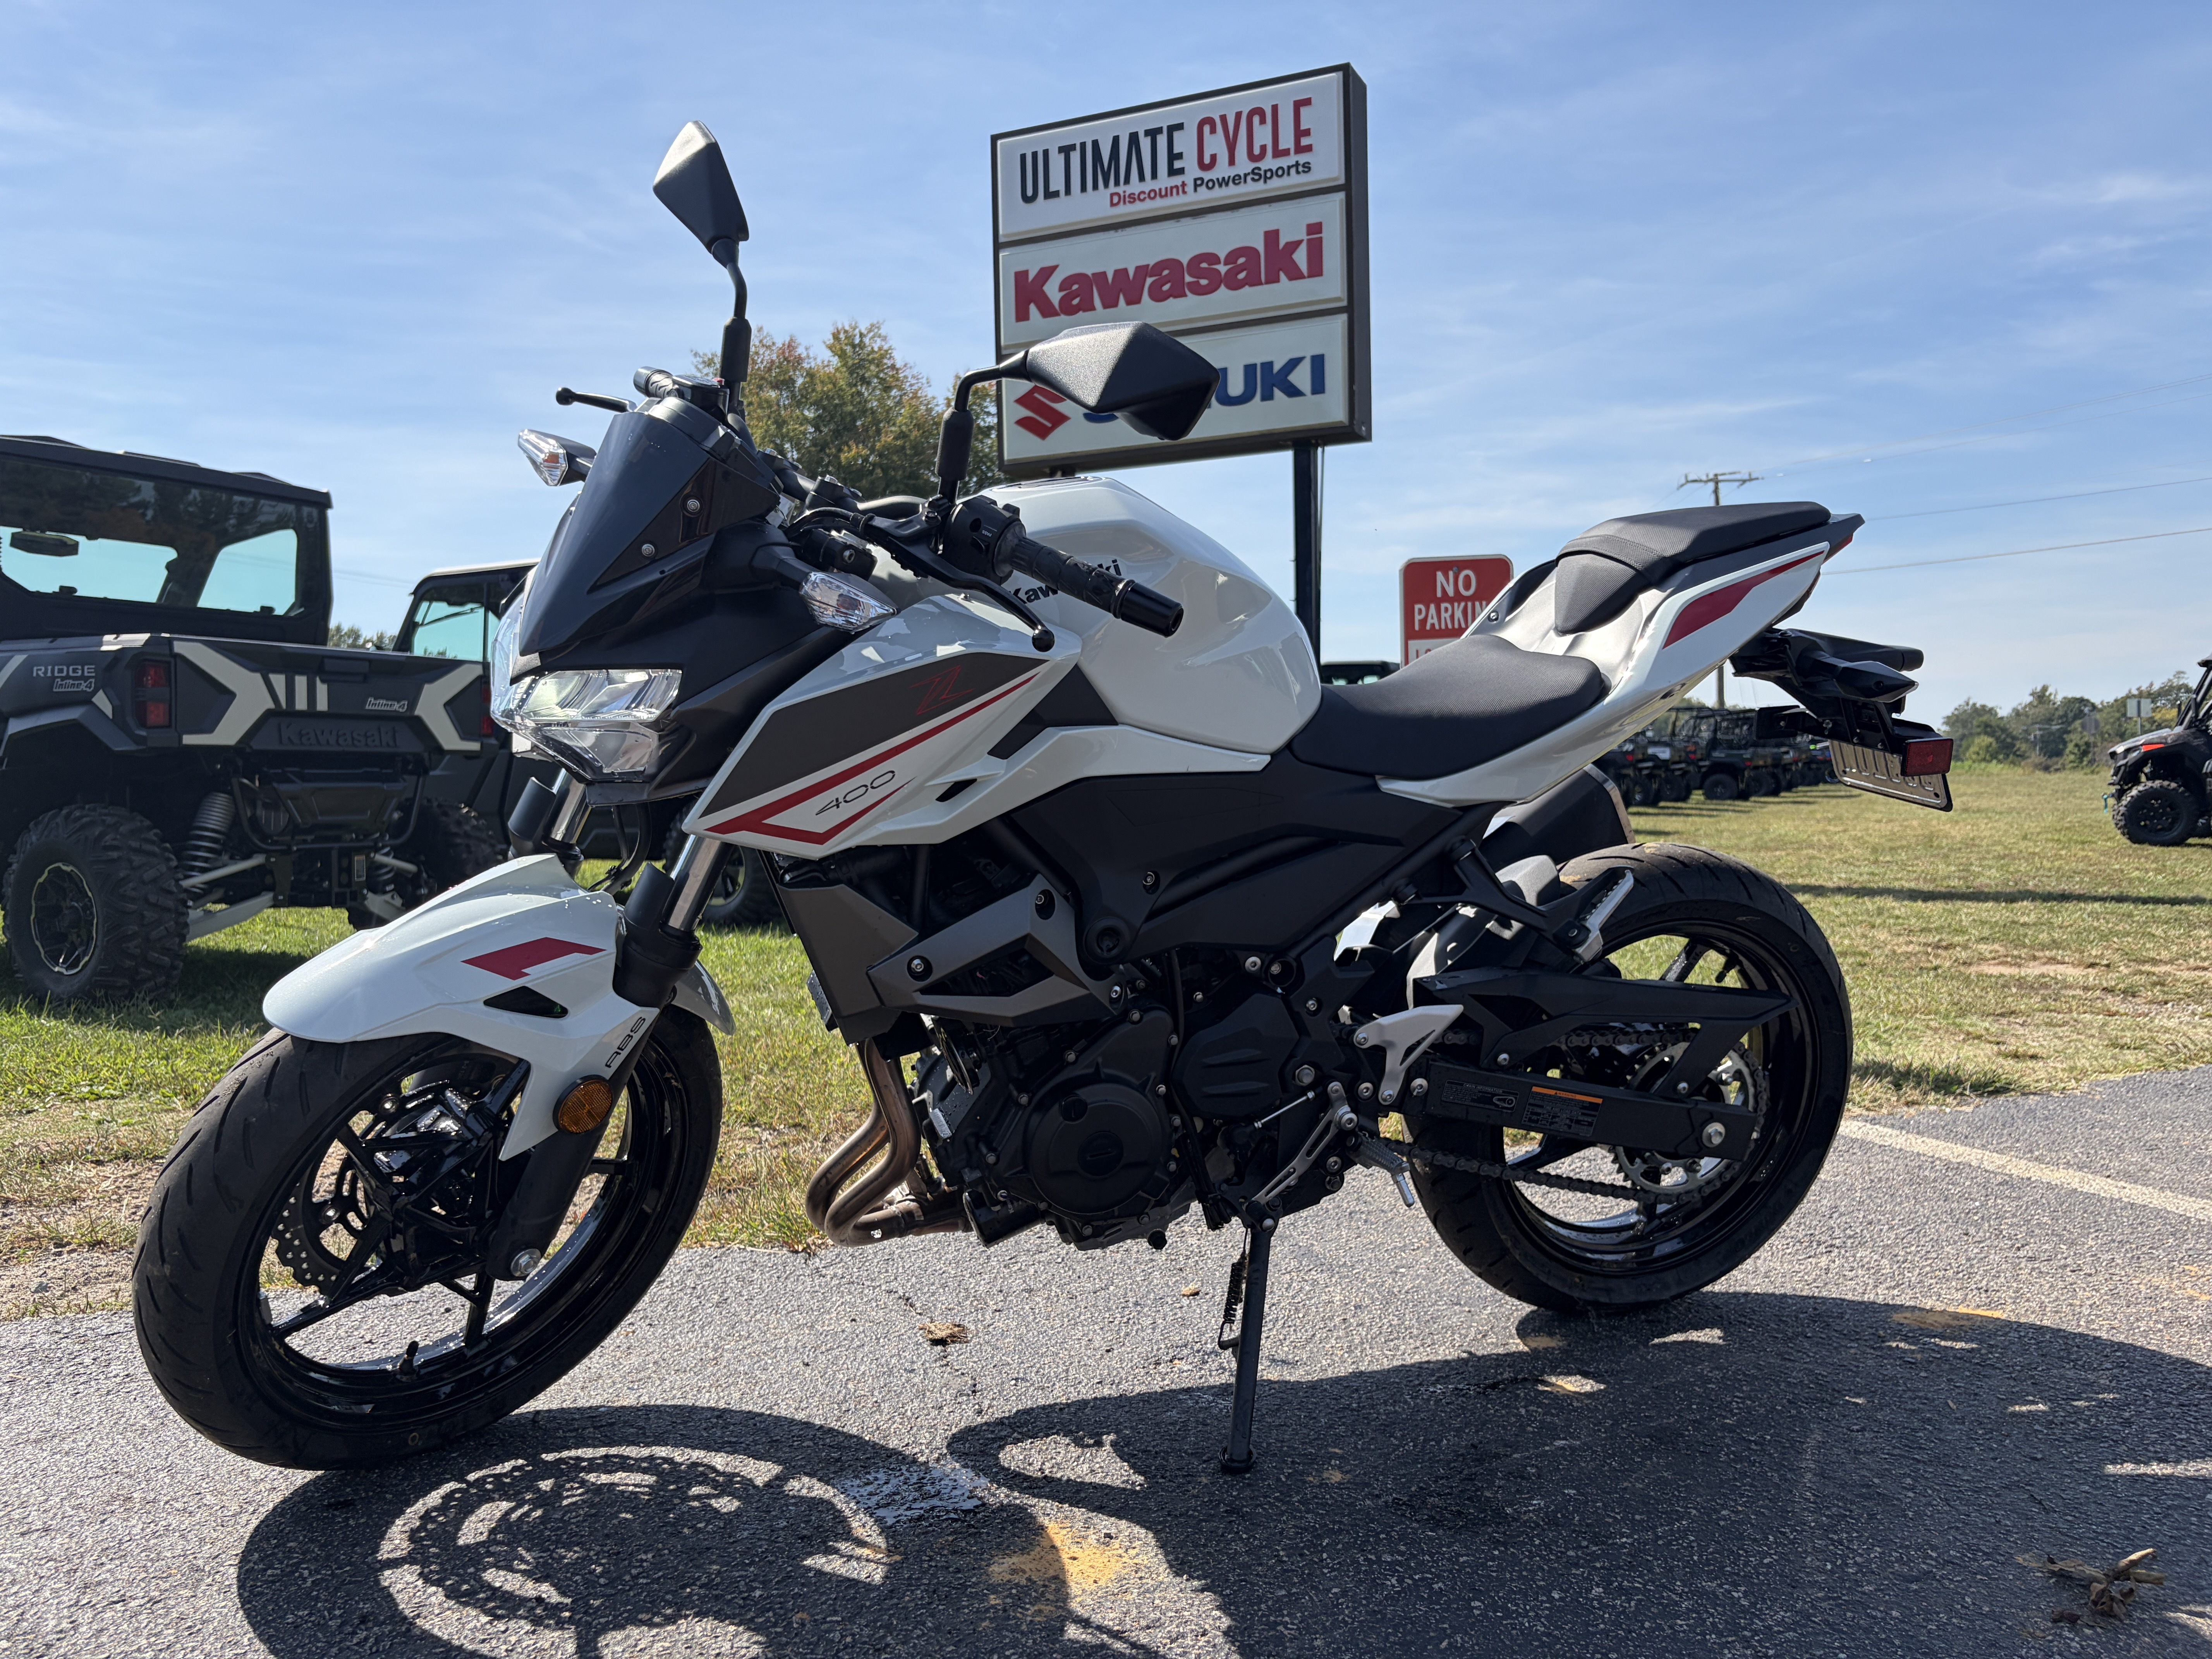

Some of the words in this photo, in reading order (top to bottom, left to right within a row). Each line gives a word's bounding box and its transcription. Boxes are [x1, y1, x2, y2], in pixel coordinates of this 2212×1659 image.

[1019, 122, 1185, 204] ULTIMATE
[1196, 96, 1313, 172] CYCLE
[1109, 180, 1188, 208] Discount
[1193, 159, 1312, 192] PowerSports
[1014, 221, 1324, 323] Kawasaki
[1436, 570, 1476, 598] NO
[1414, 601, 1486, 631] PARKIN
[33, 665, 95, 677] RIDGE
[277, 722, 400, 748] Kawasaki
[816, 770, 896, 815] 400
[605, 1016, 646, 1068] ABS
